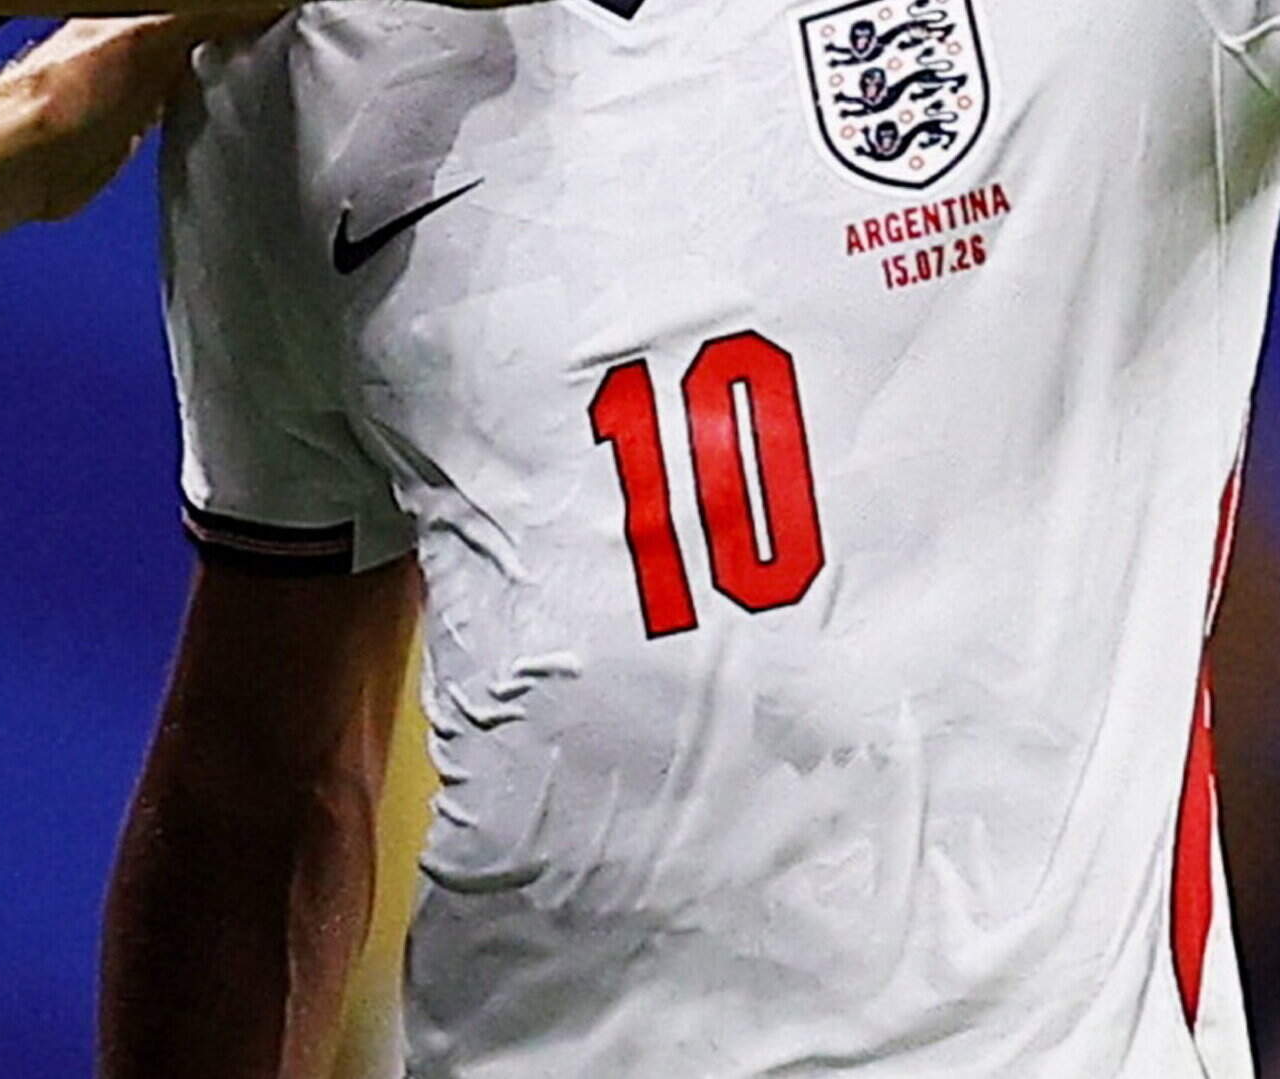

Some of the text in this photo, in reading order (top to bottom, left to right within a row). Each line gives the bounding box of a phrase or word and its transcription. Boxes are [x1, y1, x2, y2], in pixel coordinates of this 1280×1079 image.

[846, 183, 1011, 256] ARGENTINA
[881, 234, 986, 289] 15.07.26
[588, 329, 825, 640] 10
